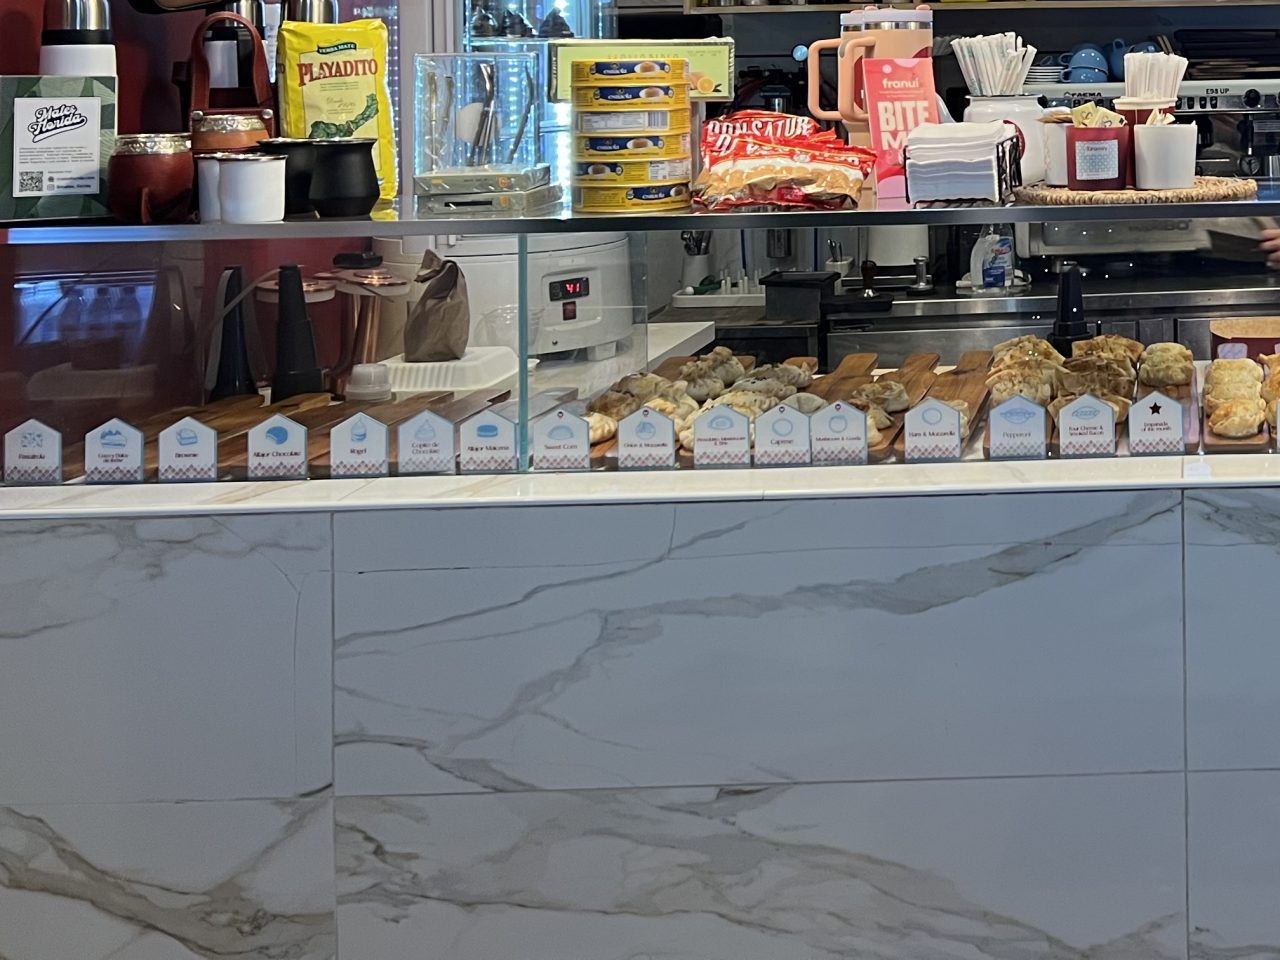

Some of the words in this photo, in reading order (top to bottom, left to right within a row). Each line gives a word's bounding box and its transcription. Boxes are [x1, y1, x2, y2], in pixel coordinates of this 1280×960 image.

[297, 58, 378, 88] PLAYADITO
[881, 78, 920, 89] franui
[877, 100, 929, 132] BITE
[565, 282, 581, 294] 41
